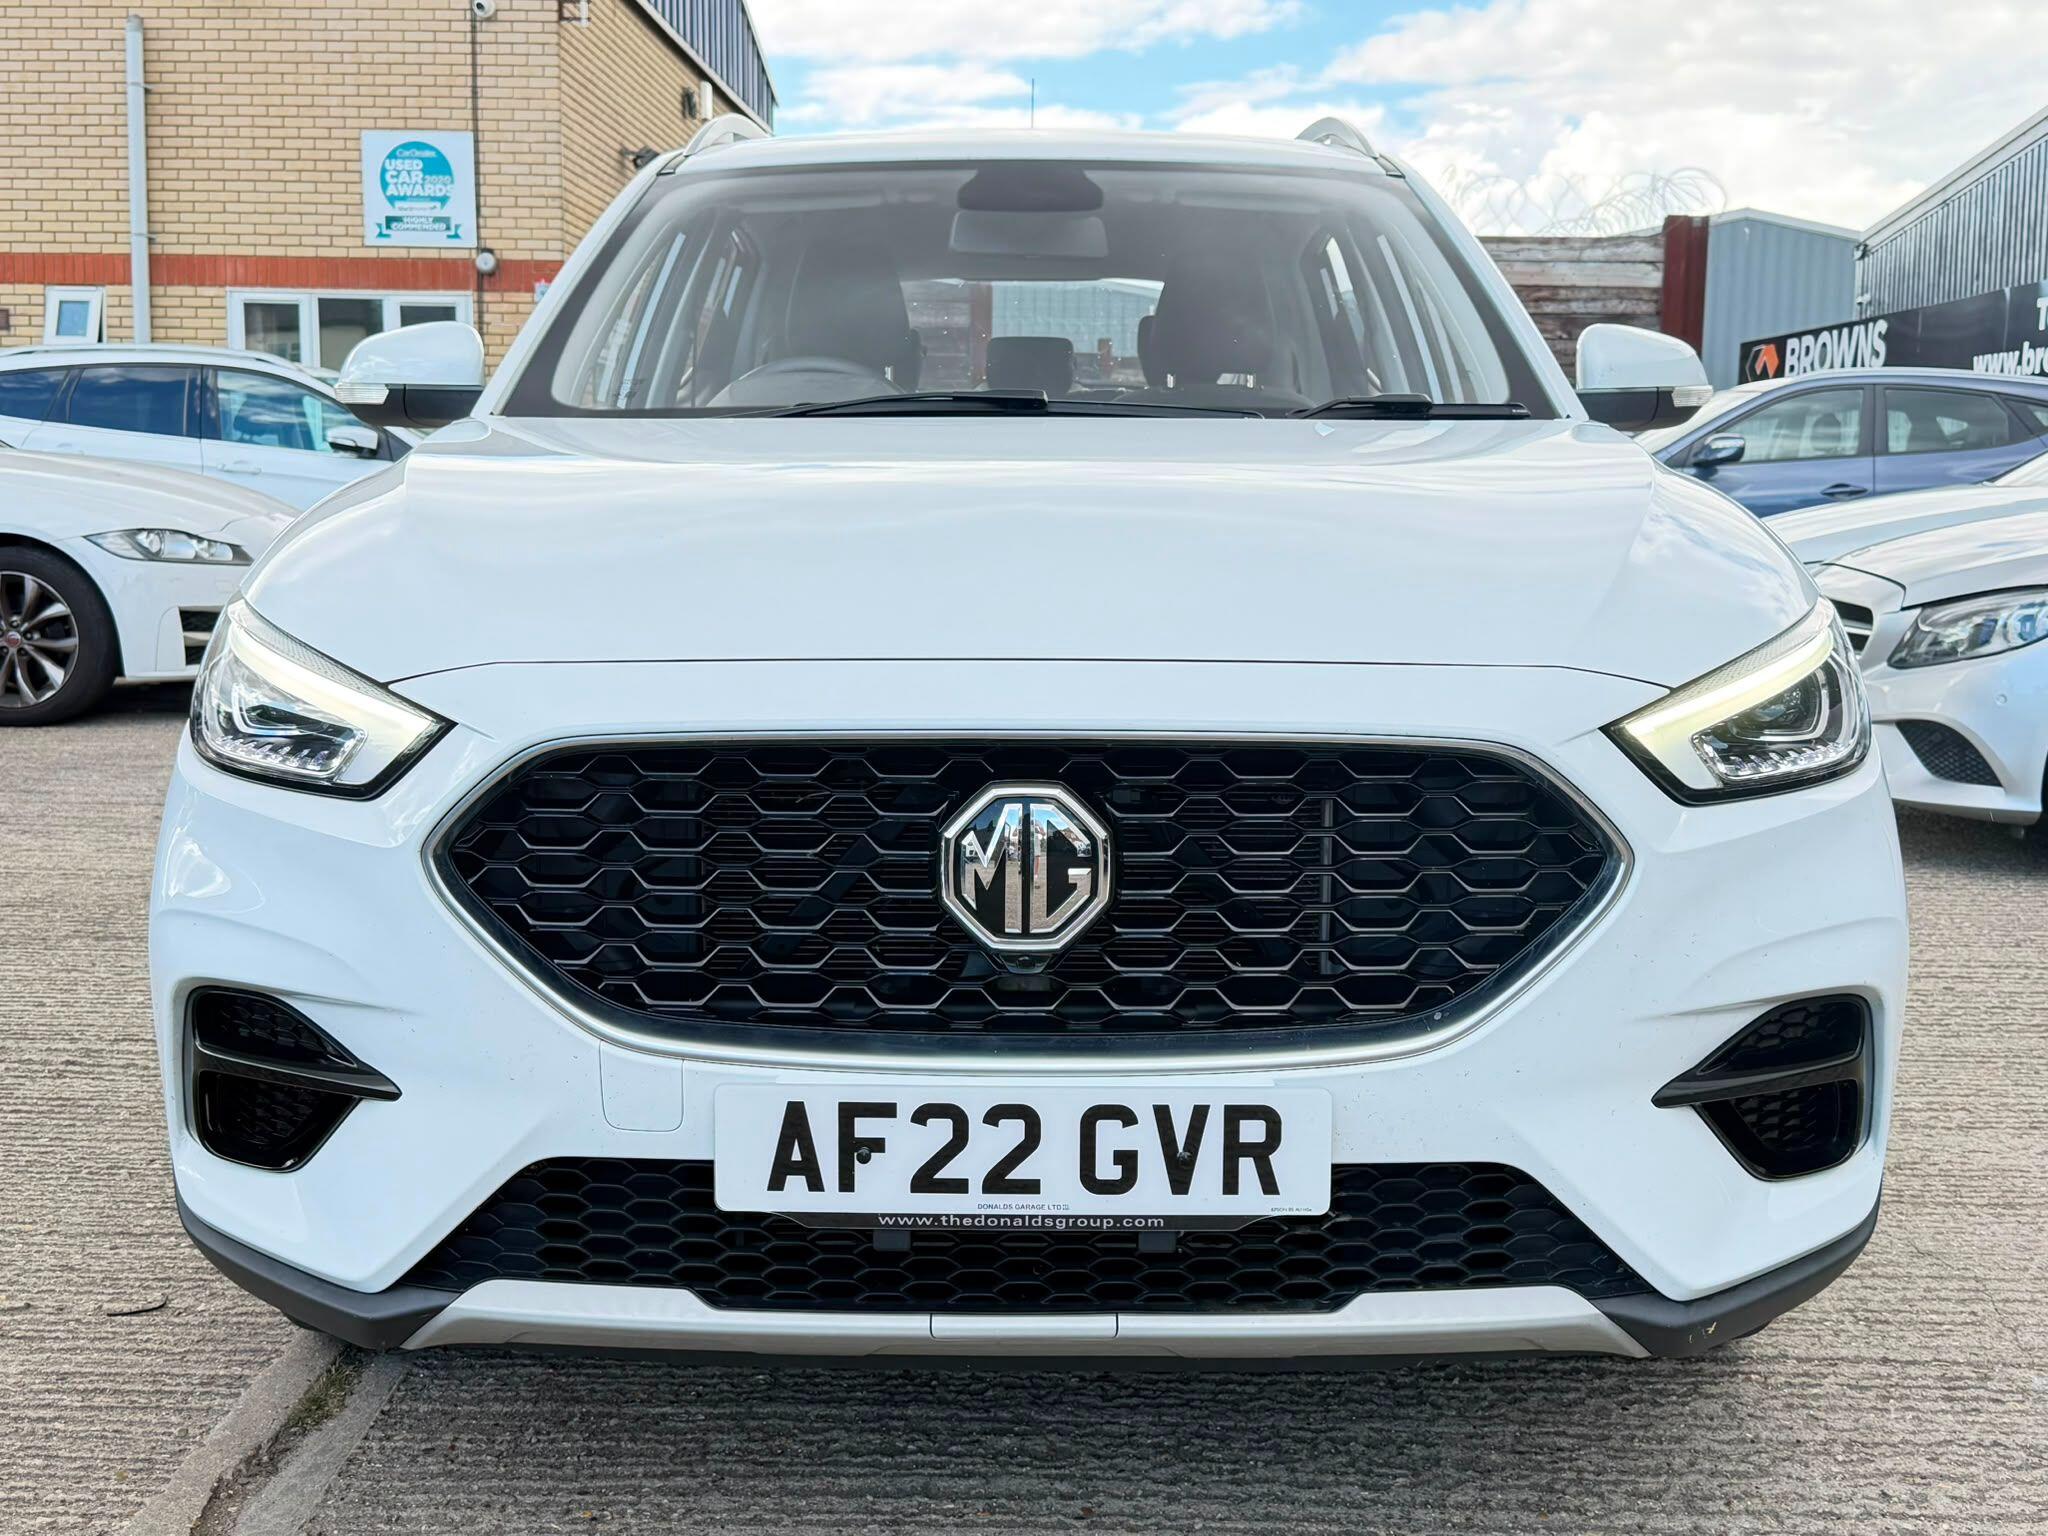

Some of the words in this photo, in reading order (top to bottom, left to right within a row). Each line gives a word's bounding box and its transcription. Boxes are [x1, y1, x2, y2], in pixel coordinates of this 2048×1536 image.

[384, 158, 423, 170] USED
[385, 171, 423, 184] CAR
[385, 183, 455, 197] AWARDS
[1784, 319, 1888, 377] BROWNS
[960, 803, 1092, 933] MG
[767, 1101, 1042, 1195] AF22
[1079, 1104, 1283, 1195] GVR
[878, 1214, 1165, 1230] www.thedonaldsgroup.com
